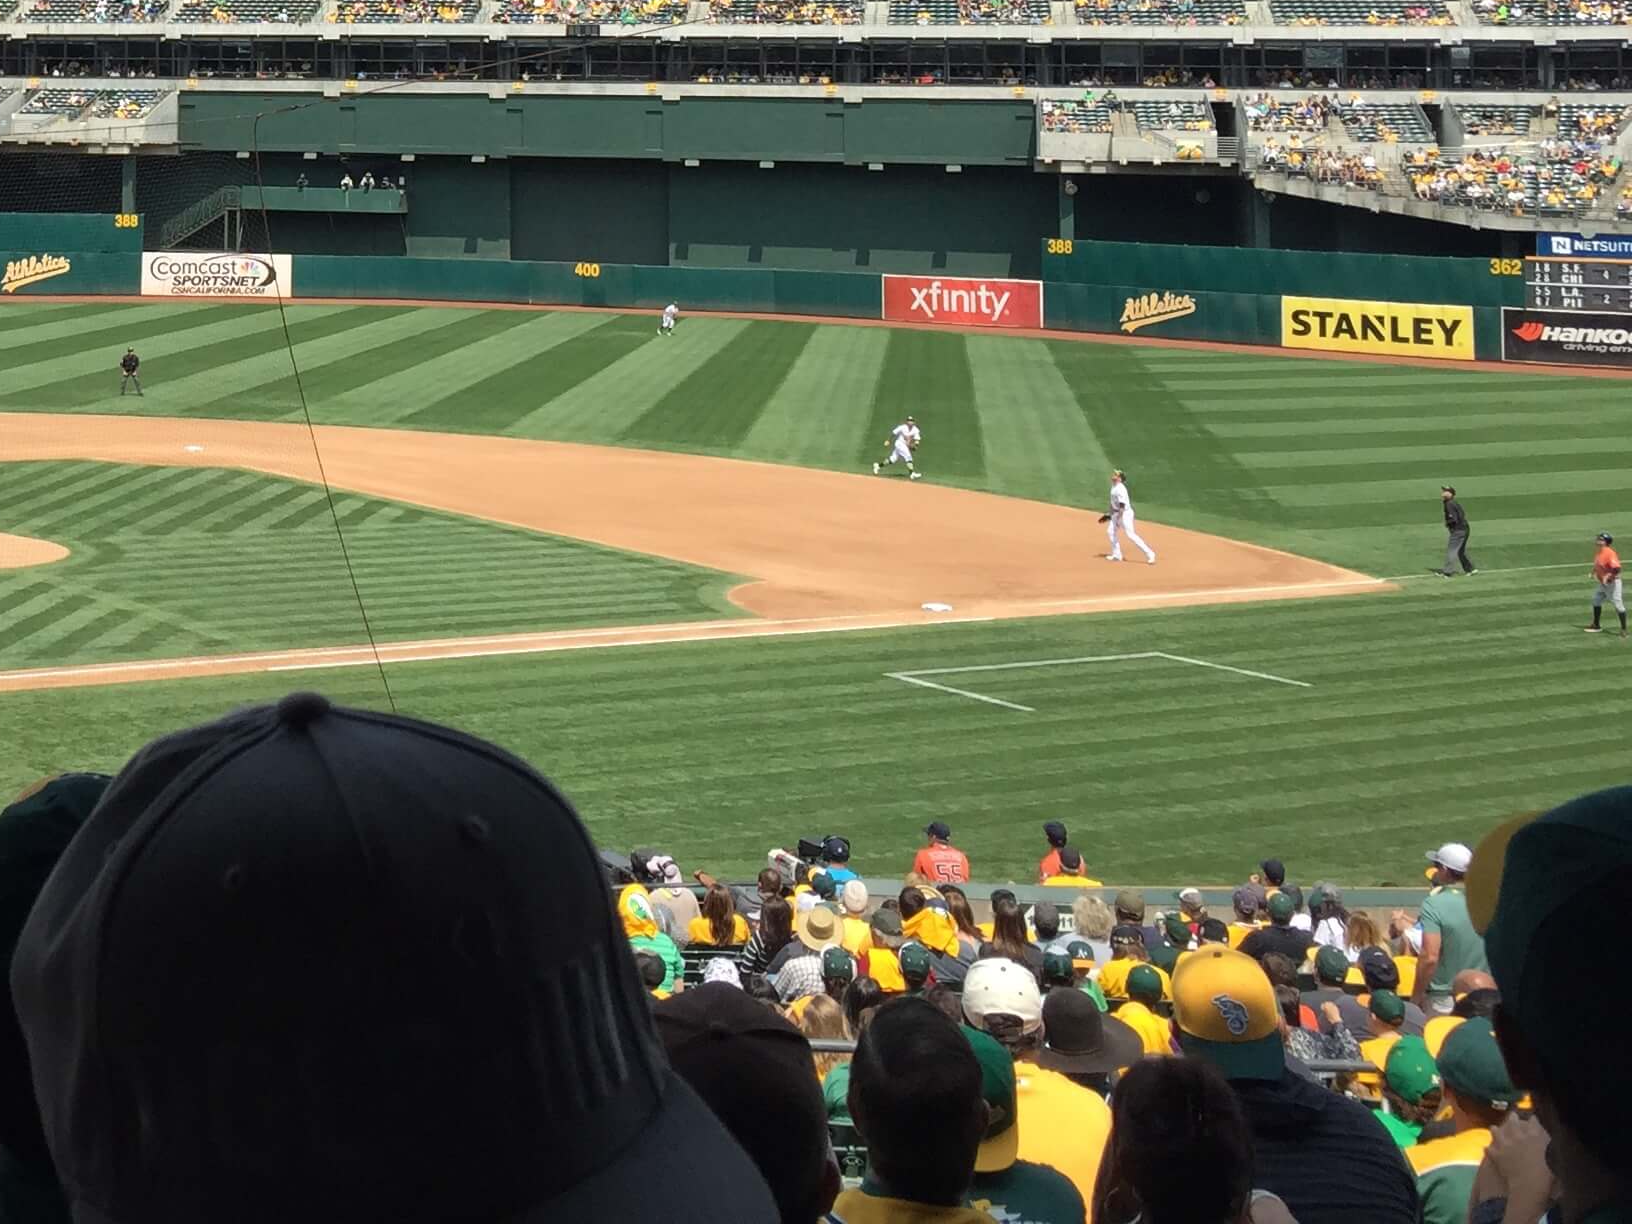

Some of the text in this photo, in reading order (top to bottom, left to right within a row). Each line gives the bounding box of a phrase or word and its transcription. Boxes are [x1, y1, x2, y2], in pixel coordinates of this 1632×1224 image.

[1048, 239, 1073, 255] 388
[1574, 240, 1632, 252] NETSUIT
[0, 253, 71, 288] Athletics
[574, 264, 600, 278] 400
[1490, 258, 1522, 275] 362
[172, 276, 260, 287] SPORTSNET
[910, 281, 1011, 321] xfinity
[1120, 291, 1196, 326] Athletics
[1291, 309, 1463, 347] STANLEY
[936, 864, 961, 883] 55
